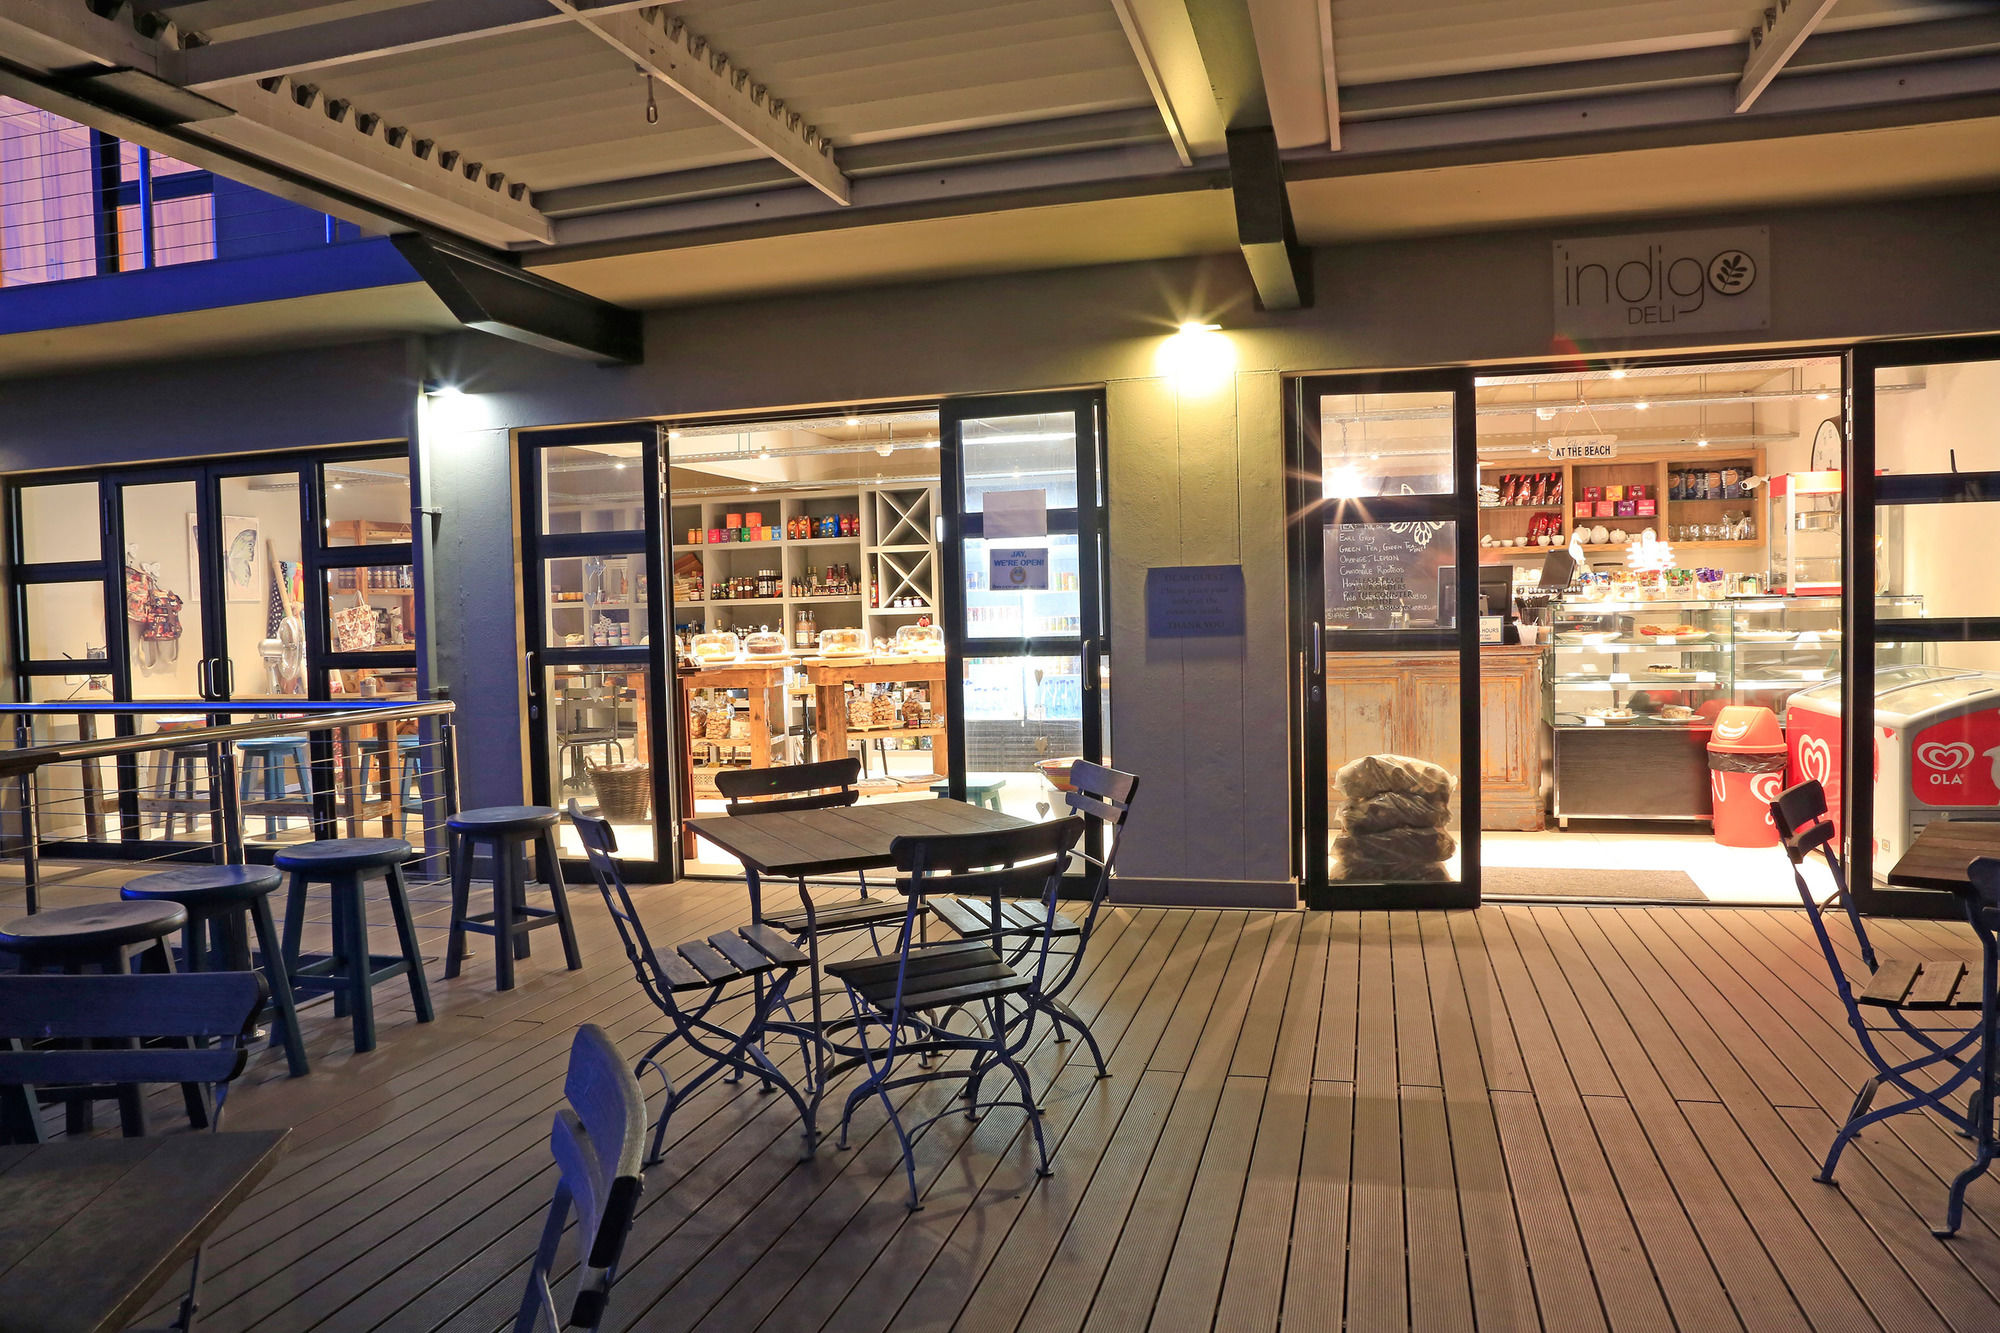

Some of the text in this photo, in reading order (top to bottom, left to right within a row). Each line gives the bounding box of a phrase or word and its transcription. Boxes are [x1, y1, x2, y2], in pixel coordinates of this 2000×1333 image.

[1565, 245, 1757, 314] indigo
[1628, 304, 1676, 325] DELI
[1556, 445, 1611, 457] AT THE BEACH
[993, 559, 1045, 567] WE'RE OPEN!
[1930, 773, 1963, 785] OLA
